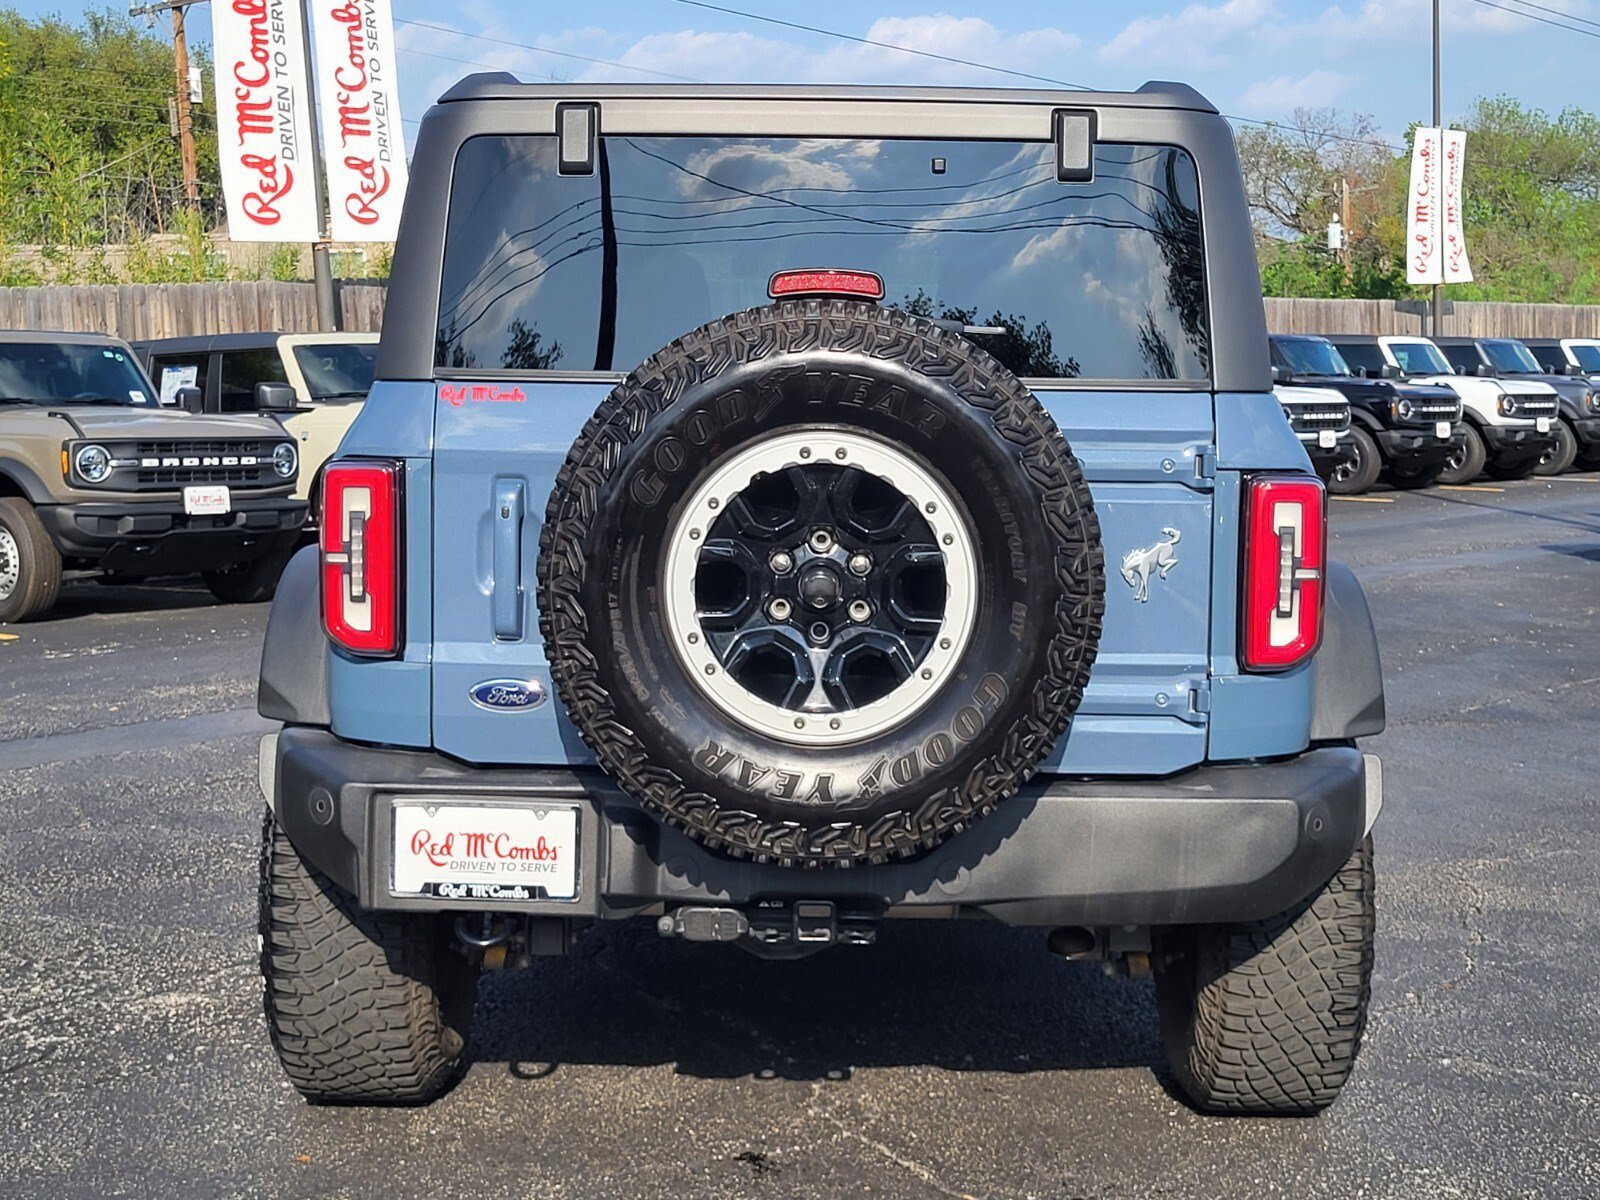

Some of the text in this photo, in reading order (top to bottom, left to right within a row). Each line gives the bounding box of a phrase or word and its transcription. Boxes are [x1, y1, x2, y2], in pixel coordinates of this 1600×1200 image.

[232, 0, 293, 226] Red McComb
[270, 0, 295, 161] DRIVEN TO SERV
[331, 0, 390, 225] Red McComb
[364, 0, 390, 162] DRIVEN TO SERV
[487, 686, 528, 704] Ford
[411, 829, 558, 867] Red McCombs
[438, 882, 530, 899] Red McCombs
[450, 860, 558, 873] DRIVEN TO SERVE
